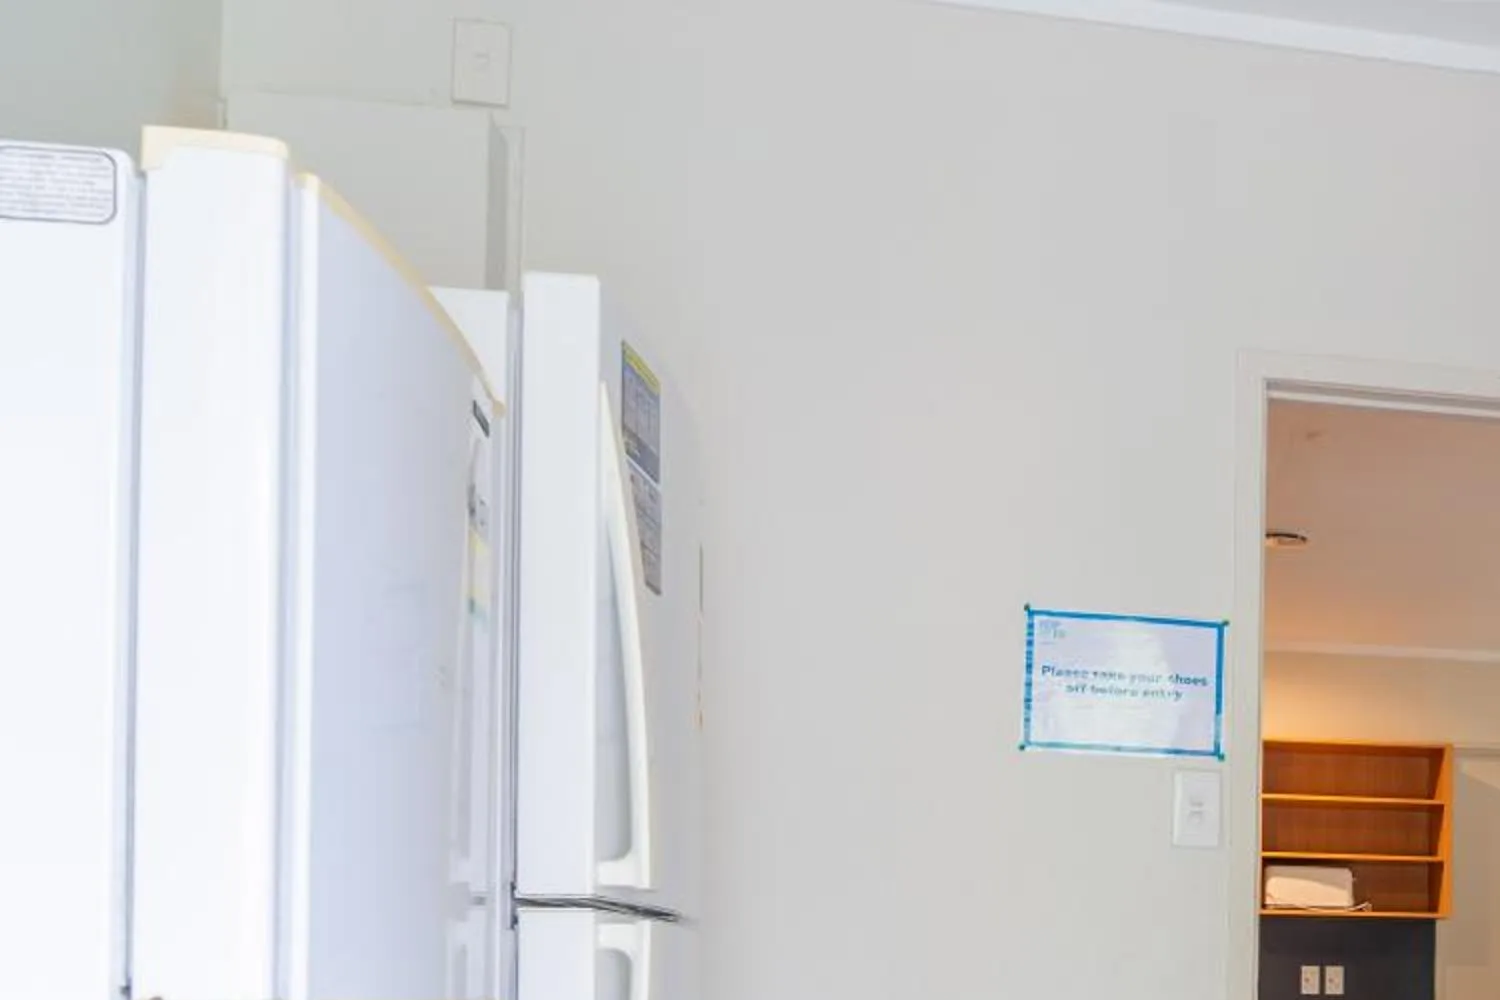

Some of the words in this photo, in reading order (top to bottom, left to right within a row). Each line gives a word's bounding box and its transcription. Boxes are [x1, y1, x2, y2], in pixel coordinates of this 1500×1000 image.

[1041, 664, 1089, 679] Please
[1128, 673, 1163, 684] your
[1169, 672, 1209, 687] shoes
[1065, 682, 1087, 694] off
[1142, 688, 1185, 701] entry
